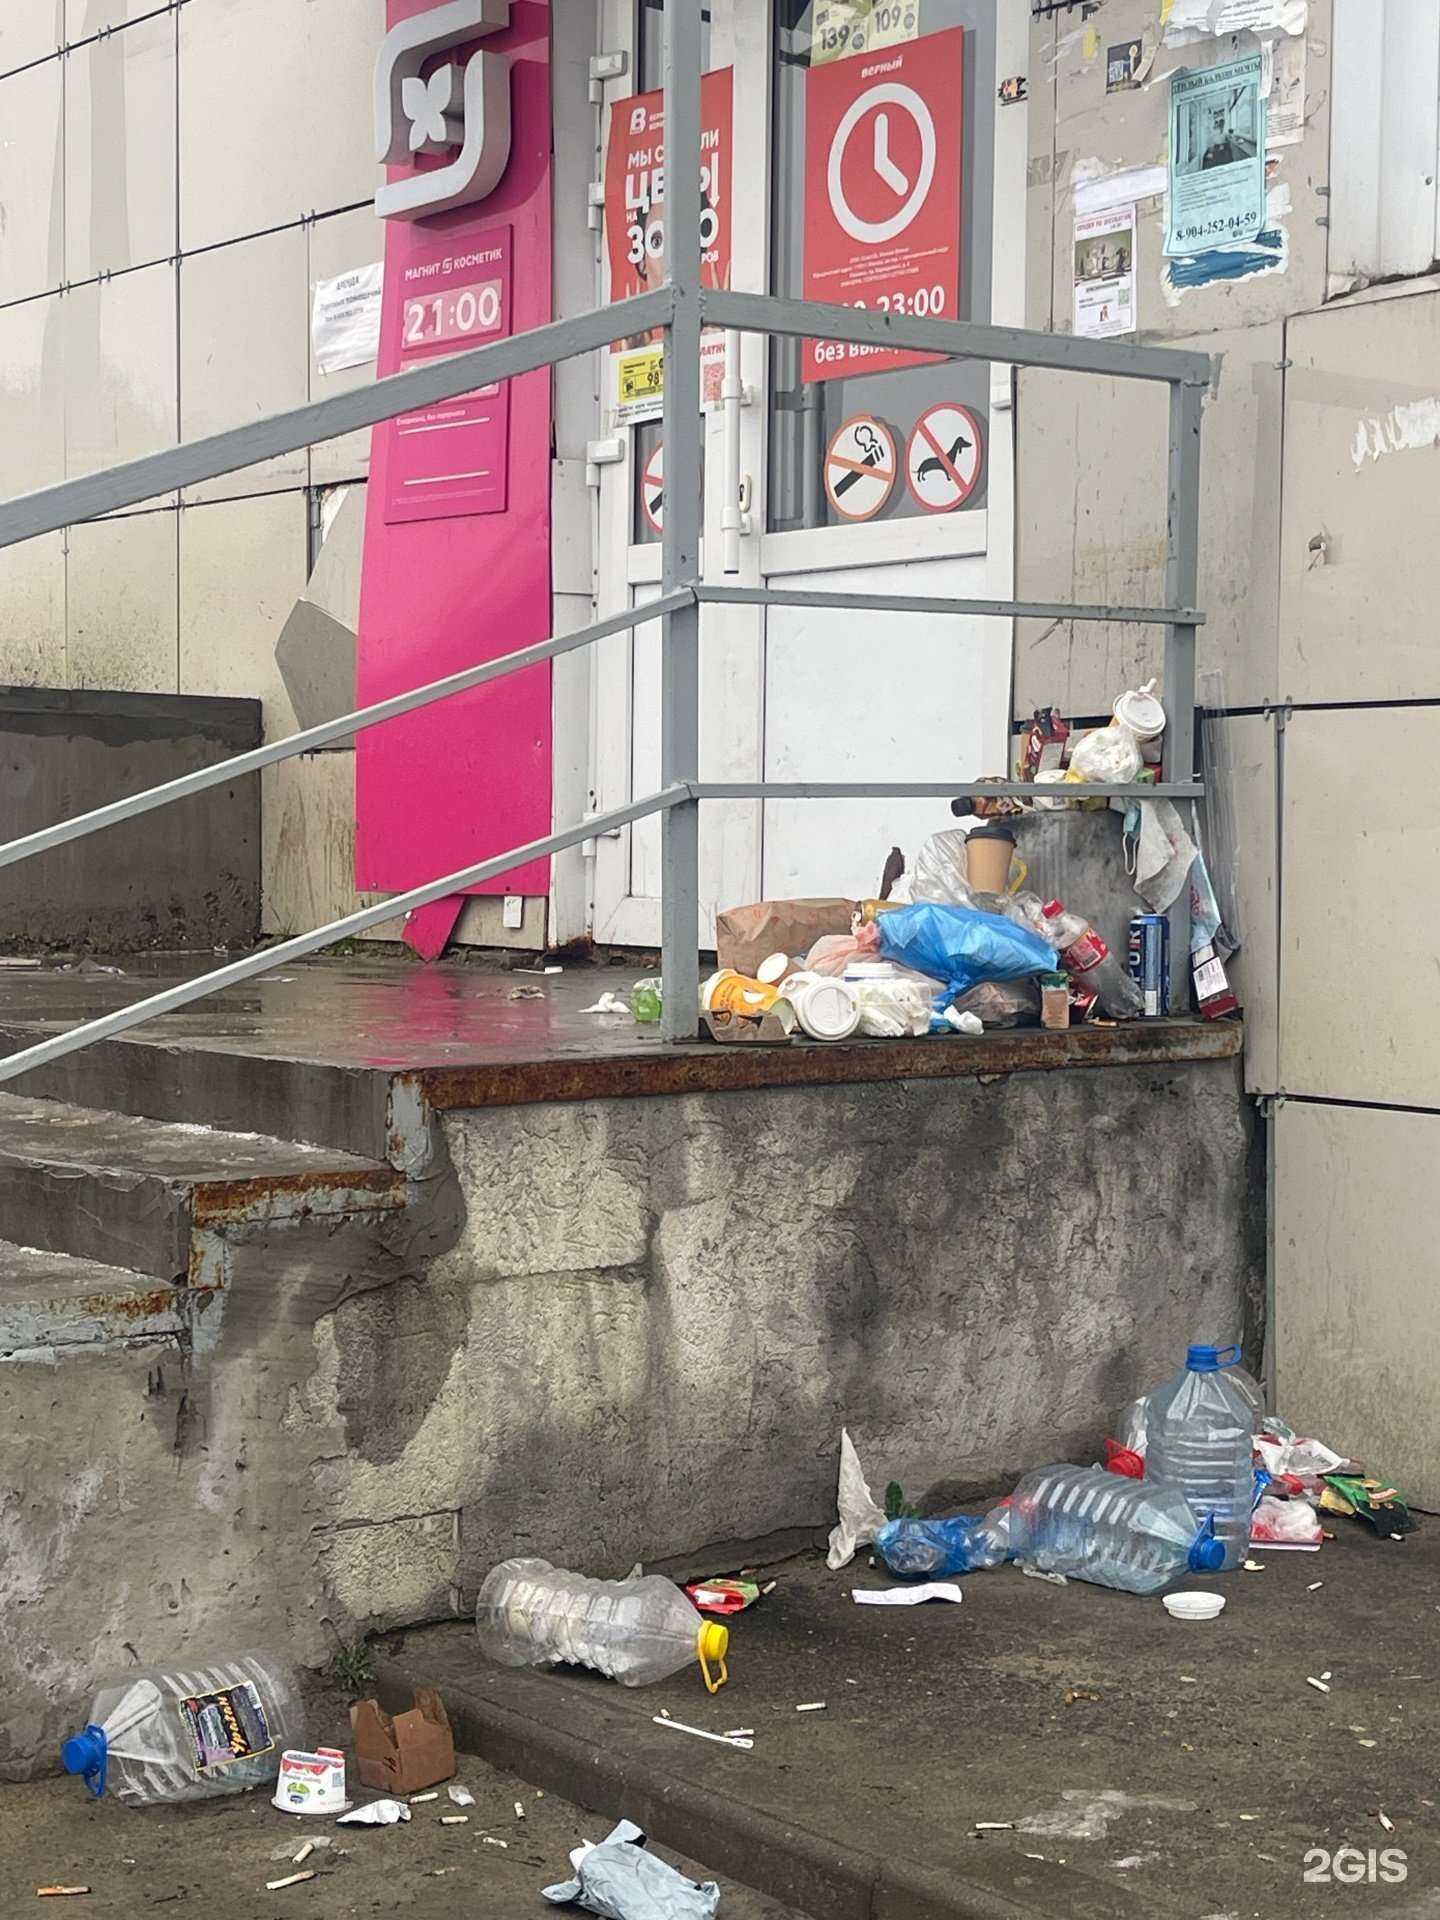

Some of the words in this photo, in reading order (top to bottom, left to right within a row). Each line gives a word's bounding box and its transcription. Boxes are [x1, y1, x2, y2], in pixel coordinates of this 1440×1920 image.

[821, 25, 850, 51] 139
[628, 147, 651, 170] МЫ
[404, 262, 441, 281] МАГНИТ
[453, 248, 503, 270] КОСМЕТИК
[407, 287, 500, 342] 21:00
[814, 341, 845, 364] без
